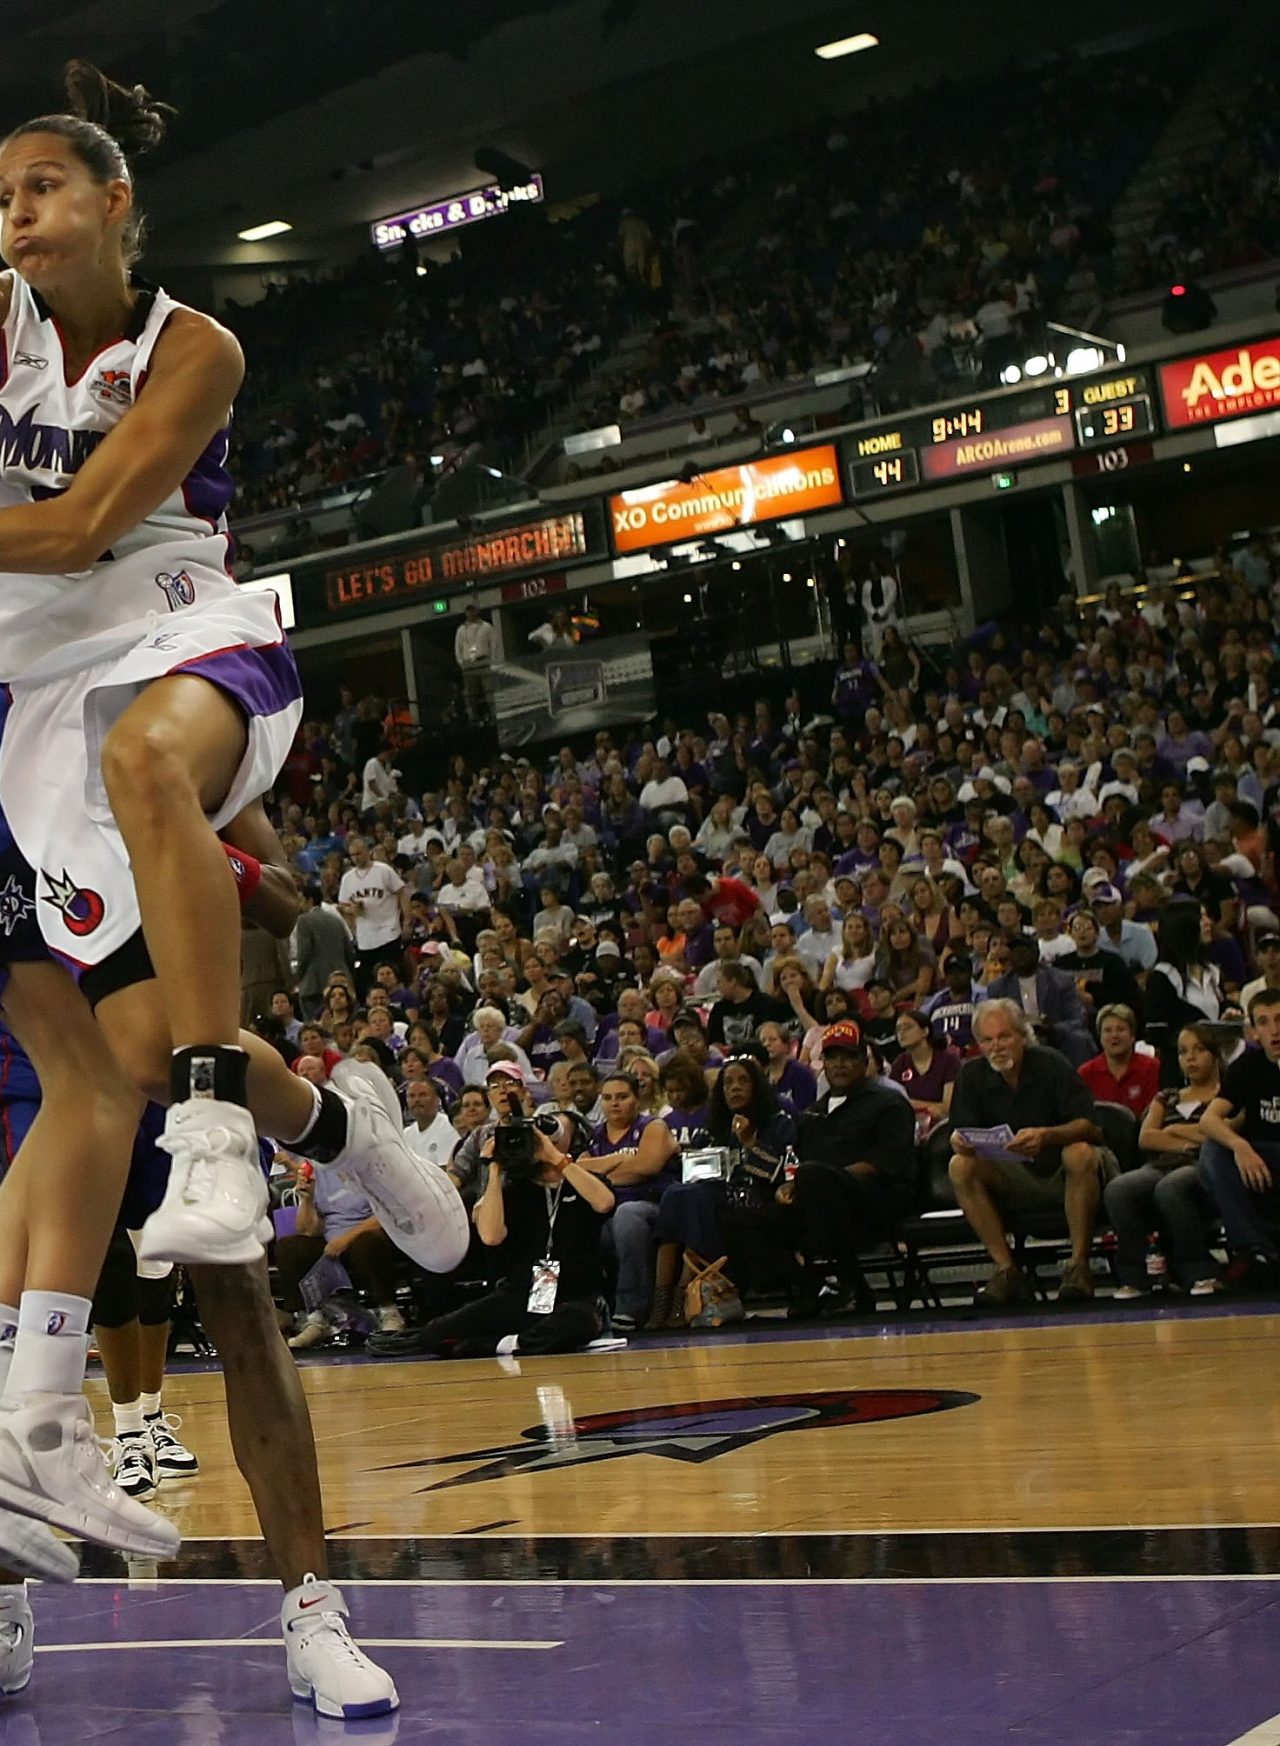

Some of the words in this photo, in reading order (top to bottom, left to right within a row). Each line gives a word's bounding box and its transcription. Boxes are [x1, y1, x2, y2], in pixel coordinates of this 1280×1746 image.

[447, 202, 466, 223] &
[1083, 377, 1136, 405] GUEST
[1181, 349, 1280, 407] Ade
[1055, 388, 1070, 415] 3
[932, 409, 983, 443] 9:44
[1103, 405, 1133, 435] 33
[858, 432, 902, 457] HOME
[956, 429, 1063, 466] ARCOArena.com
[873, 458, 902, 485] 44
[1096, 447, 1129, 472] 103
[615, 508, 647, 533] XO
[651, 465, 835, 524] Communcations
[337, 565, 394, 602] LET'S
[404, 556, 432, 584] GO
[521, 579, 547, 598] 102
